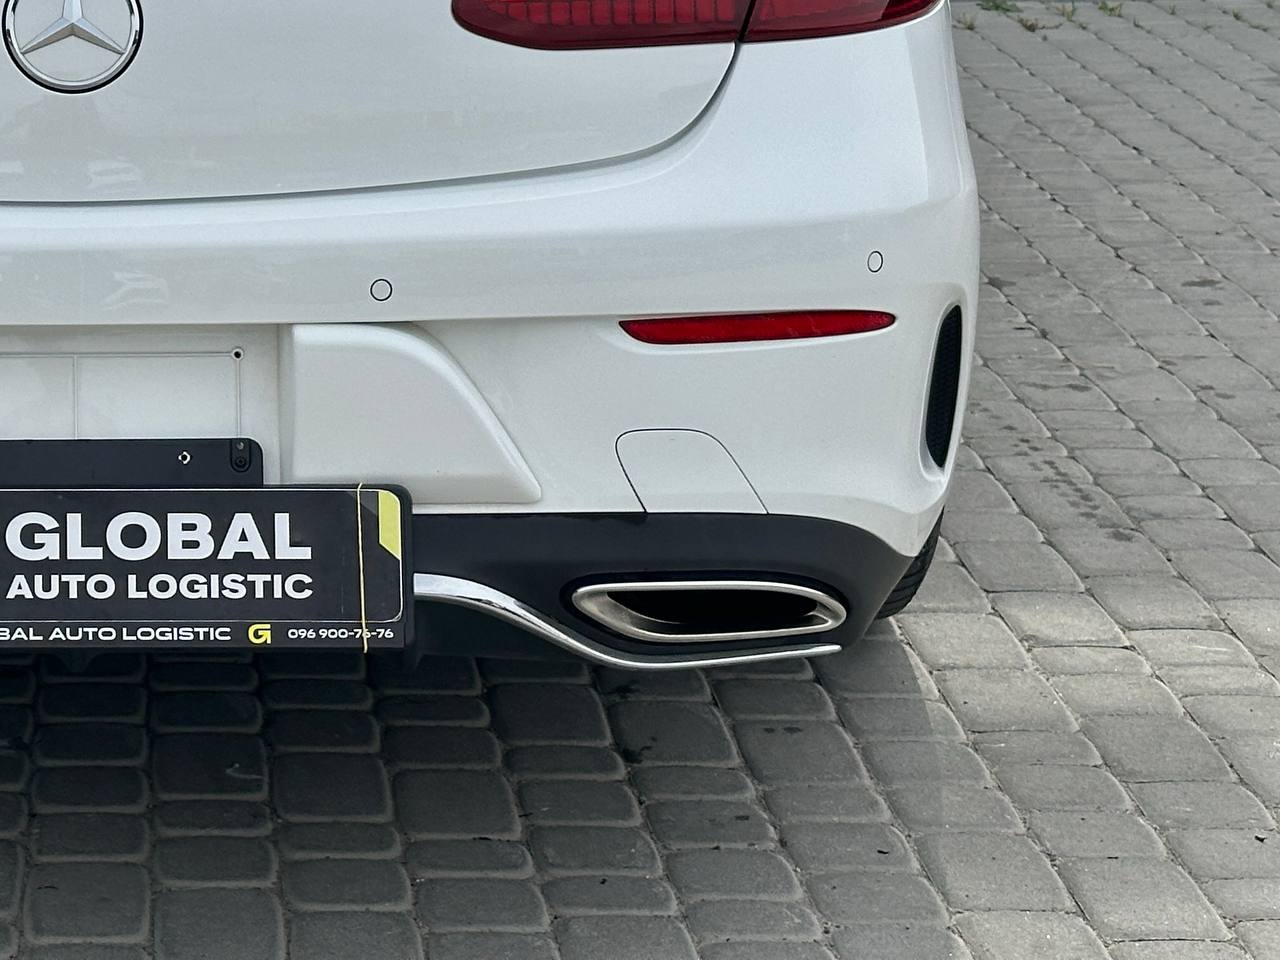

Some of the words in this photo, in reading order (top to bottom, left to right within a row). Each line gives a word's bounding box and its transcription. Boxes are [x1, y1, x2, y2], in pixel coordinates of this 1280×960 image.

[5, 512, 313, 561] GLOBAL
[6, 574, 115, 600] AUTO
[127, 573, 313, 600] LOGISTIC
[48, 627, 117, 641] AUTO
[122, 627, 231, 641] LOGISTIC
[287, 628, 317, 639] 096
